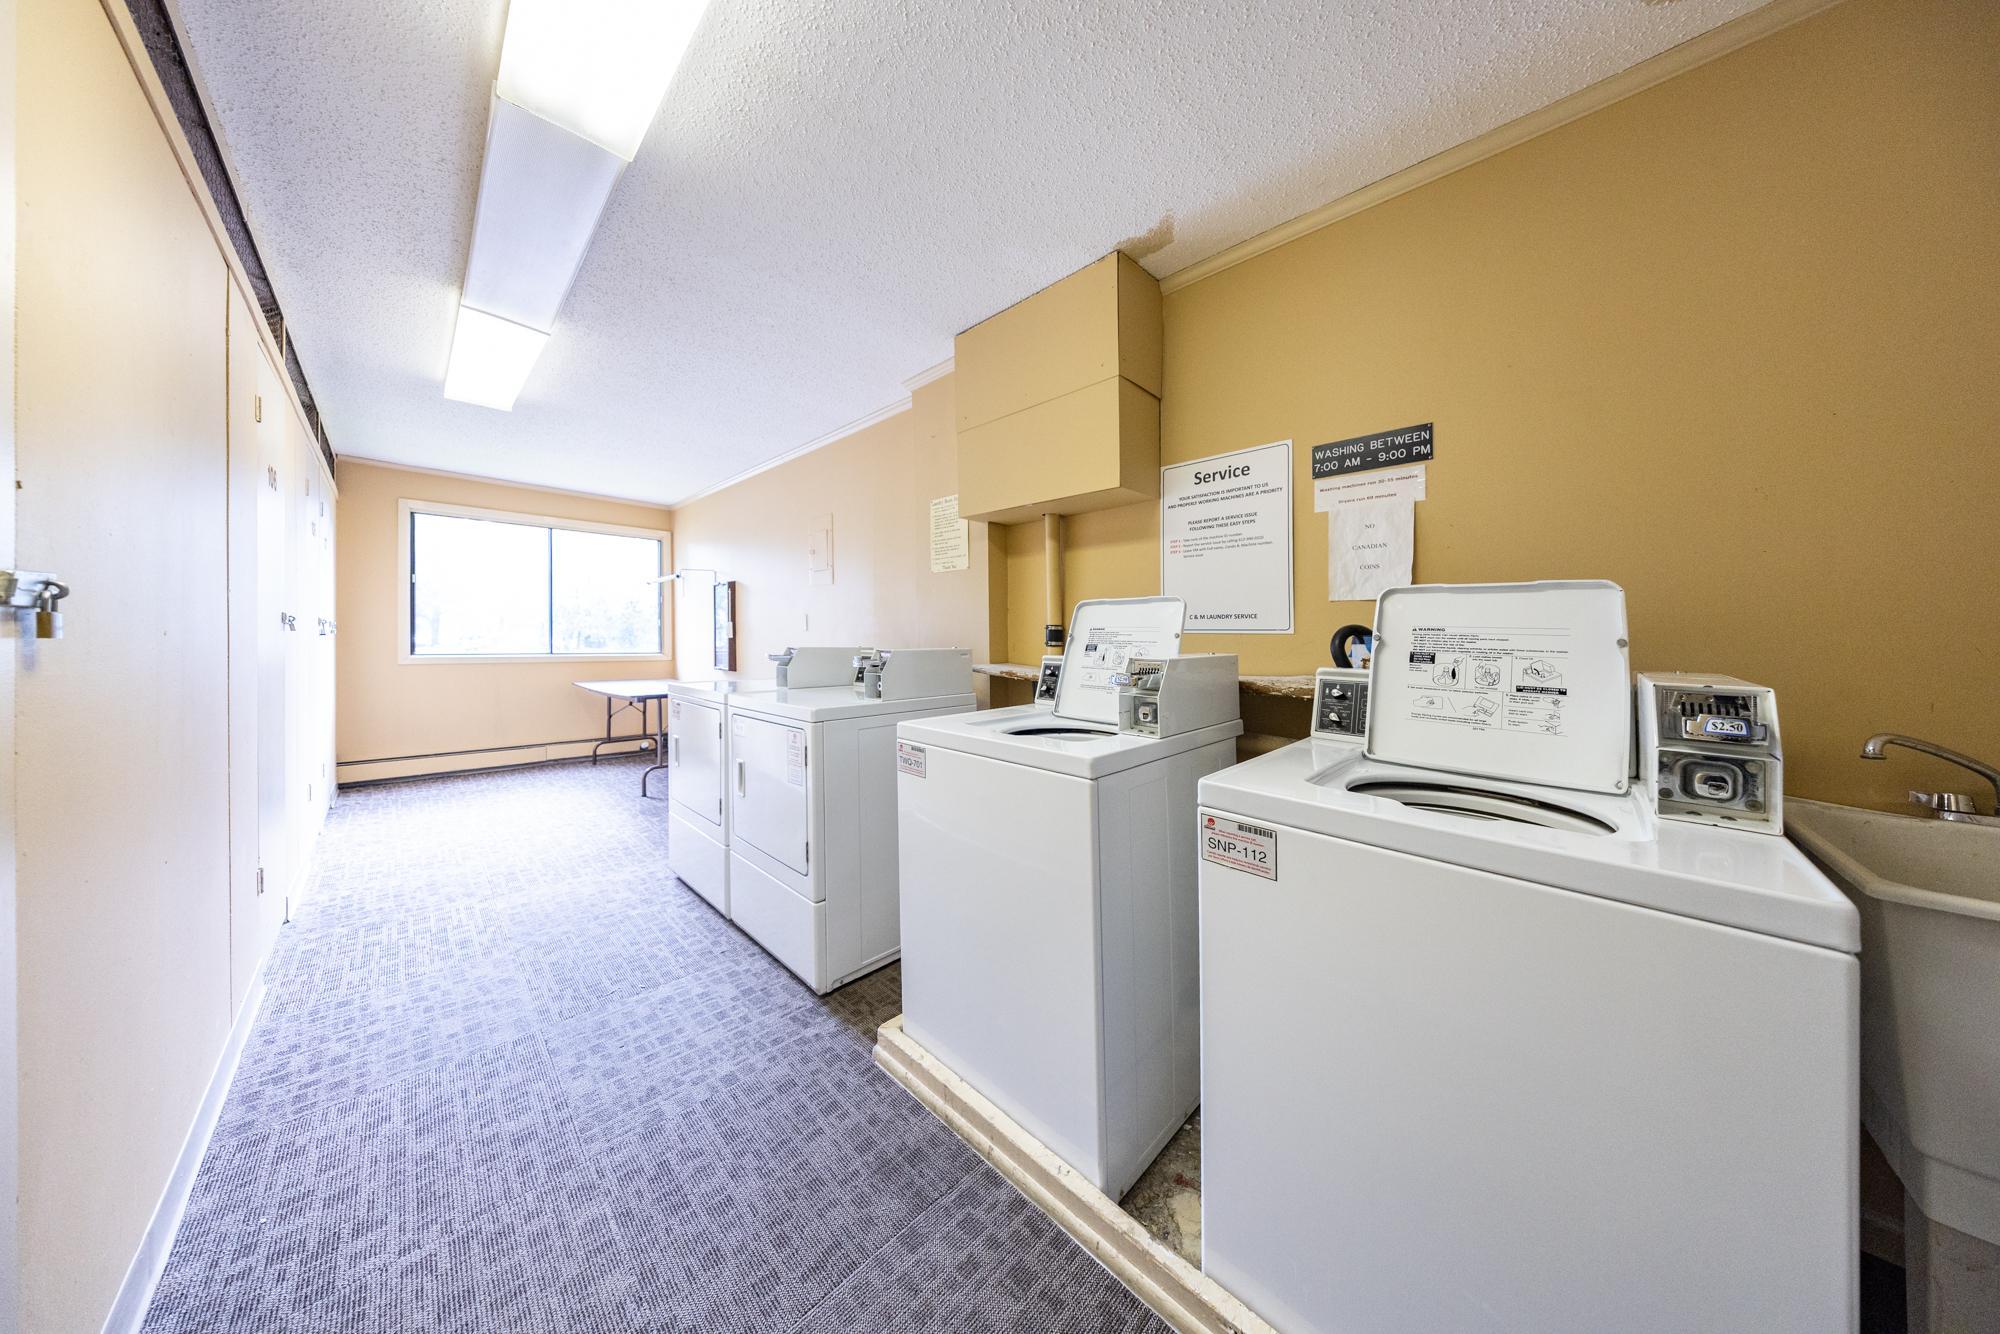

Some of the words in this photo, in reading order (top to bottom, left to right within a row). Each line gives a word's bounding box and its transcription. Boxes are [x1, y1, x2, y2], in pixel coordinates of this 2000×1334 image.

[1315, 443, 1364, 460] WASHING
[1370, 430, 1430, 450] BETWEEN
[1314, 461, 1338, 473] 7:00
[1344, 456, 1361, 468] AM
[1378, 448, 1406, 462] 9:00
[1412, 444, 1431, 456] PM
[1194, 463, 1250, 485] Service
[1177, 500, 1198, 508] PROPERLY
[1198, 496, 1220, 505] WORKING
[1220, 493, 1245, 502] MACHINES
[1260, 487, 1283, 495] PRIORITY
[1191, 490, 1220, 499] SATISFACTION
[1225, 485, 1253, 494] IMPORTANT
[1189, 524, 1215, 532] FOLLOWING
[1352, 542, 1388, 551] CANADIAN
[1711, 721, 1744, 732] $2.50
[1208, 837, 1267, 864] SNP-112
